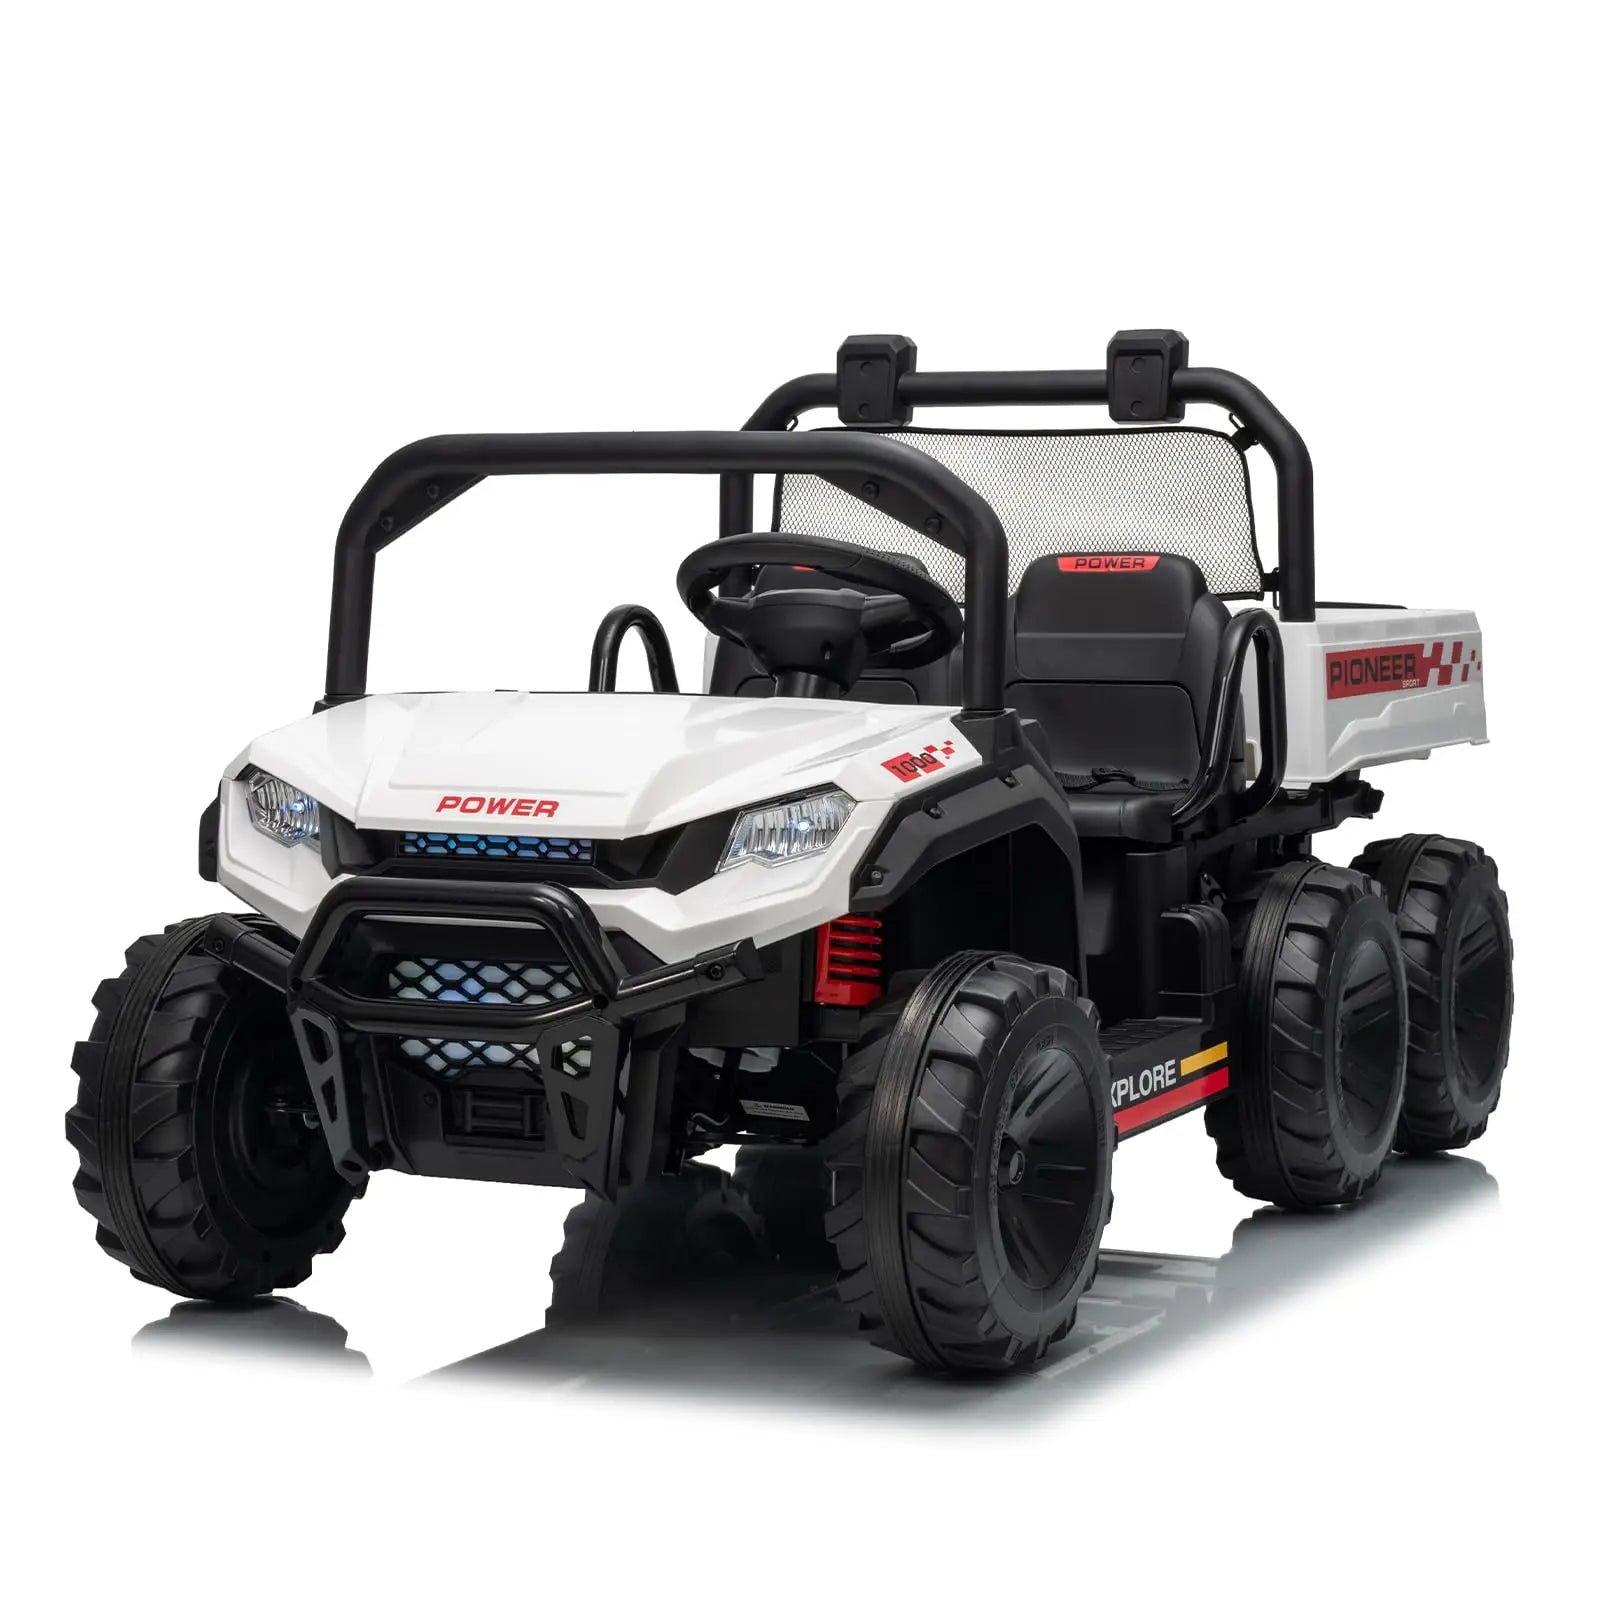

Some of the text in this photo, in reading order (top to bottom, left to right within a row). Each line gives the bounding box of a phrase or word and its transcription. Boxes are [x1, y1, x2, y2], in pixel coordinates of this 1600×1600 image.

[1075, 557, 1145, 569] POWER
[1330, 653, 1416, 688] PIONEER
[1402, 678, 1420, 688] SPORT
[891, 752, 938, 777] 1000
[436, 796, 560, 818] POWER
